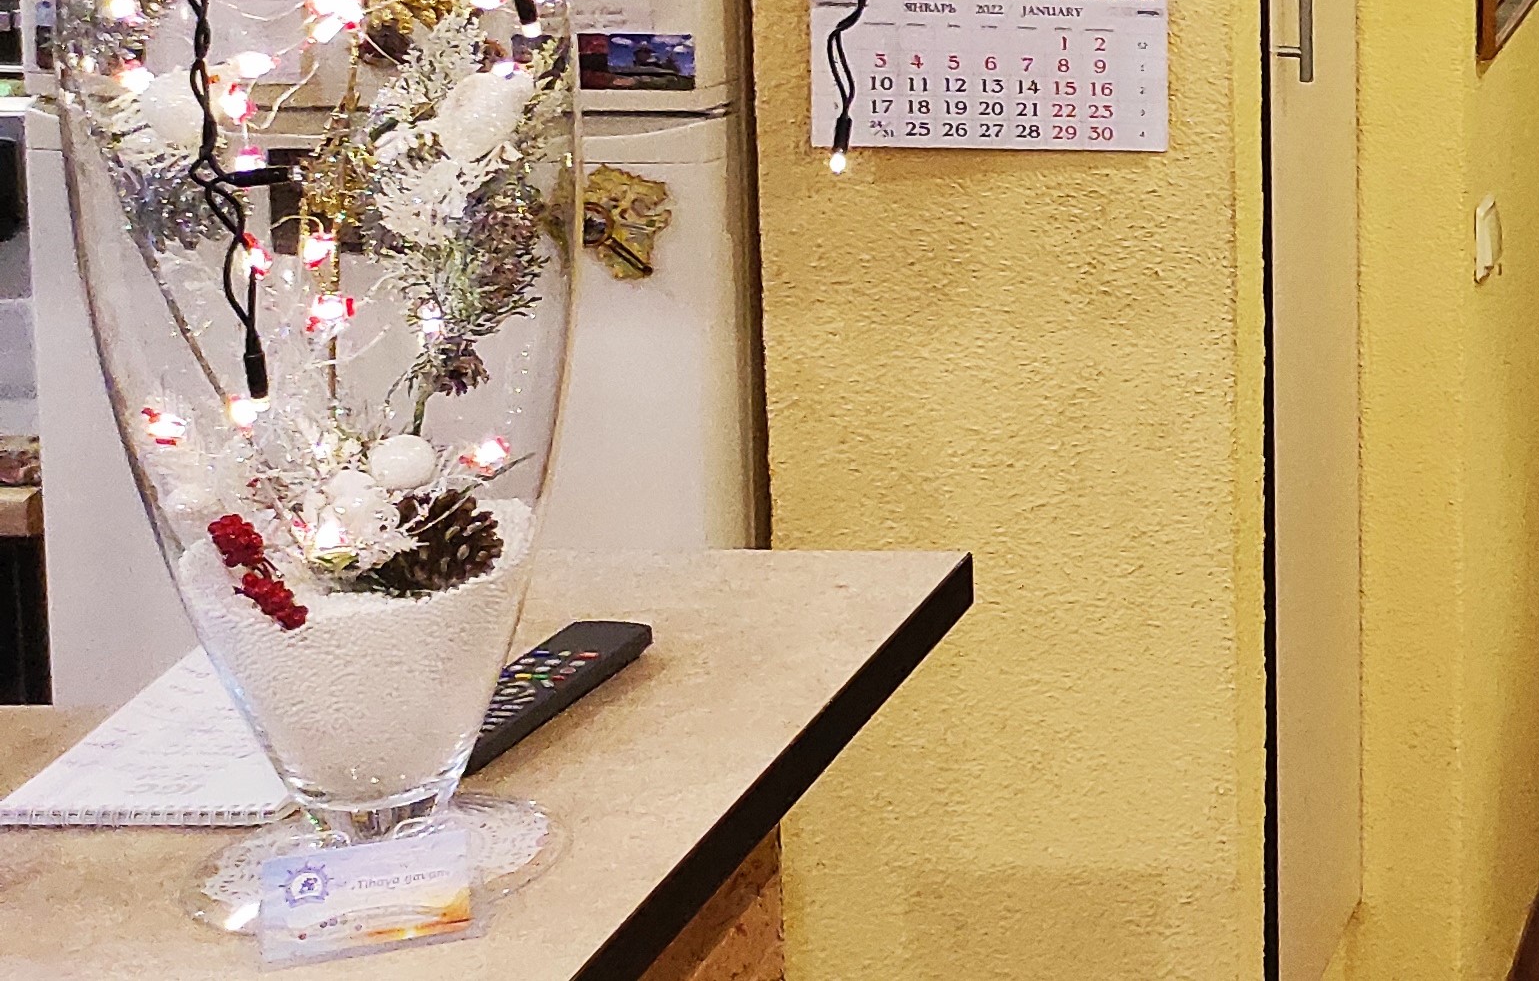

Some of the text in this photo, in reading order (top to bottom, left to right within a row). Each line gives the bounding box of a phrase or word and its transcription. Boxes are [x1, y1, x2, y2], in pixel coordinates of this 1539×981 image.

[904, 2, 1083, 18] ЯНВАРЬ 2022 JANUARY
[1061, 35, 1068, 51] 1
[1094, 37, 1106, 52] 2
[874, 53, 887, 68] 3
[910, 54, 924, 69] 4
[947, 55, 960, 70] 5
[984, 56, 998, 71] 6
[1021, 57, 1034, 72] 7
[1057, 58, 1070, 73] 8
[1093, 59, 1107, 74] 9
[870, 75, 893, 91] 10
[908, 77, 929, 92] 11
[944, 77, 967, 93] 12
[981, 78, 1004, 94] 13
[1017, 79, 1041, 95] 14
[1054, 80, 1077, 96] 15
[1090, 81, 1113, 97] 16
[871, 99, 893, 114] 17
[907, 99, 931, 115] 18
[943, 100, 968, 115] 19
[978, 101, 1004, 116] 20
[1015, 102, 1038, 117] 21
[1051, 103, 1076, 118] 22
[1088, 104, 1113, 119] 23
[905, 121, 931, 137] 25
[942, 122, 968, 138] 26
[979, 123, 1004, 138] 27
[1015, 124, 1041, 139] 28
[1052, 125, 1077, 140] 29
[1088, 126, 1113, 141] 30
